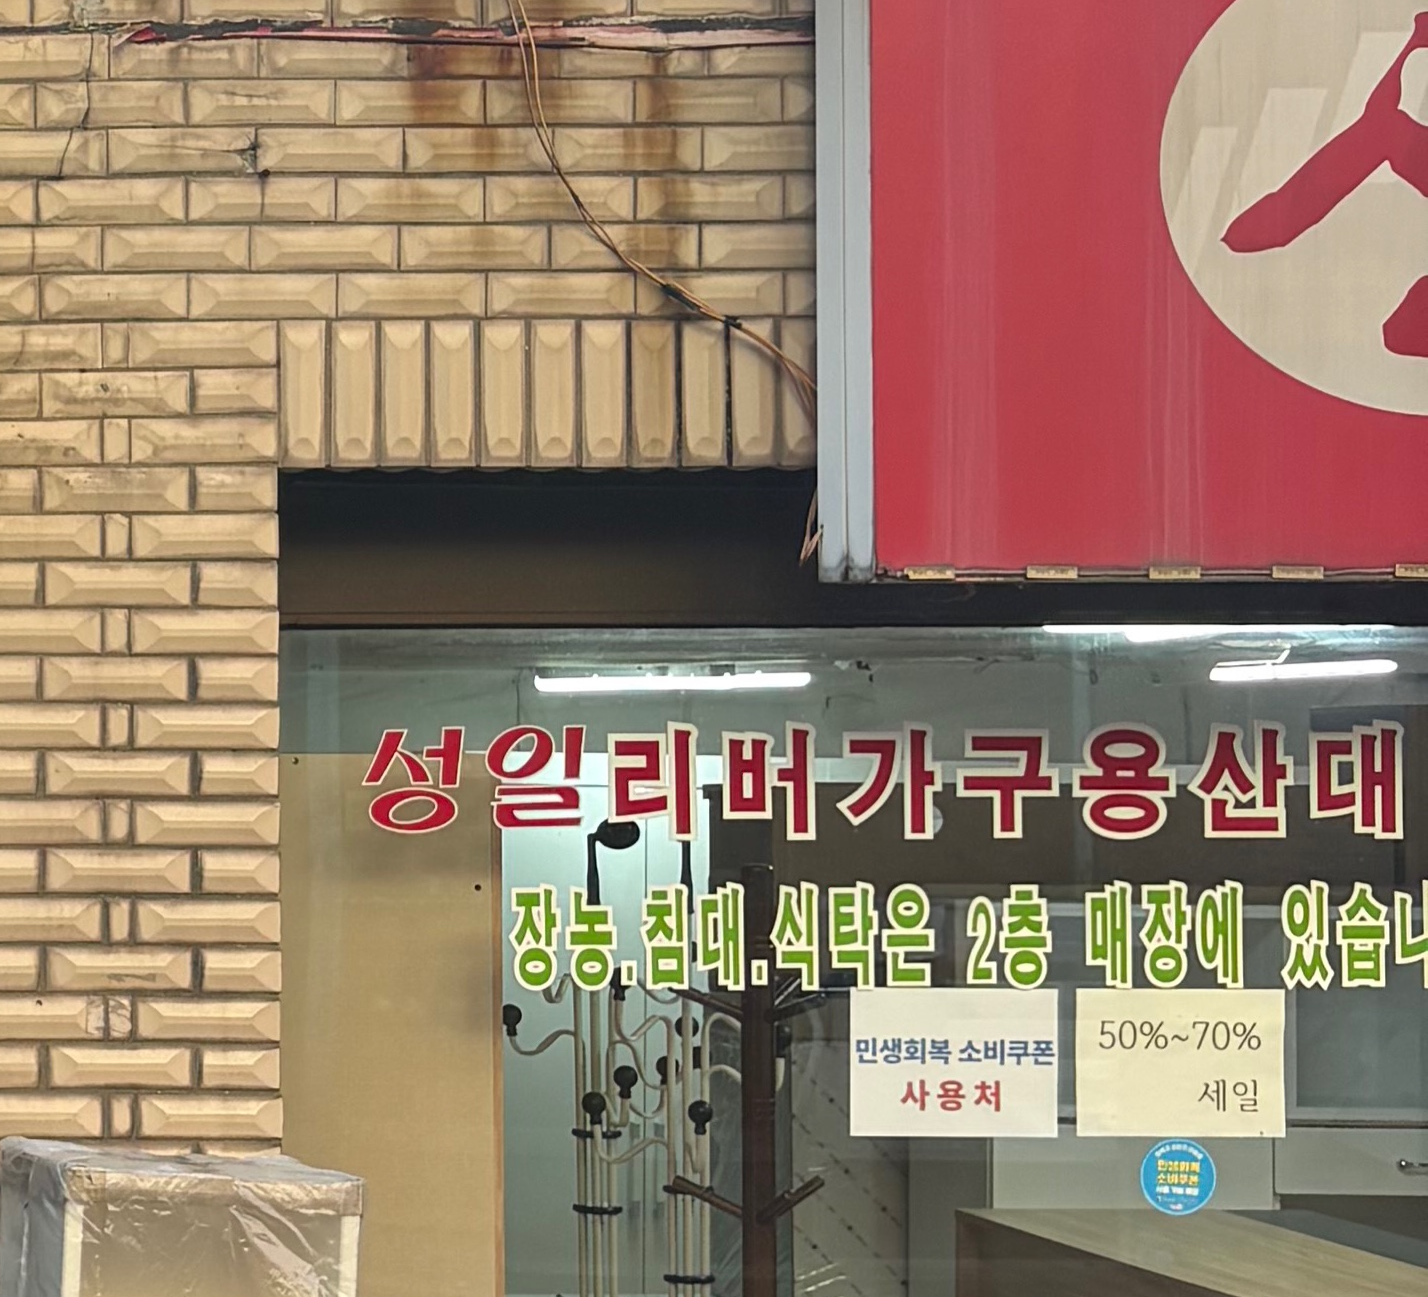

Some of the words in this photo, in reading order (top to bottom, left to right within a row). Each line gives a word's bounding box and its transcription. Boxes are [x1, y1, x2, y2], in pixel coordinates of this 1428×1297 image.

[966, 883, 1052, 990] 2층
[1085, 879, 1244, 990] 매장에
[855, 1038, 952, 1066] 민생회복
[958, 1038, 1056, 1066] 소비쿠폰
[1098, 1020, 1262, 1051] 50%~70%
[1197, 1078, 1260, 1113] 세일
